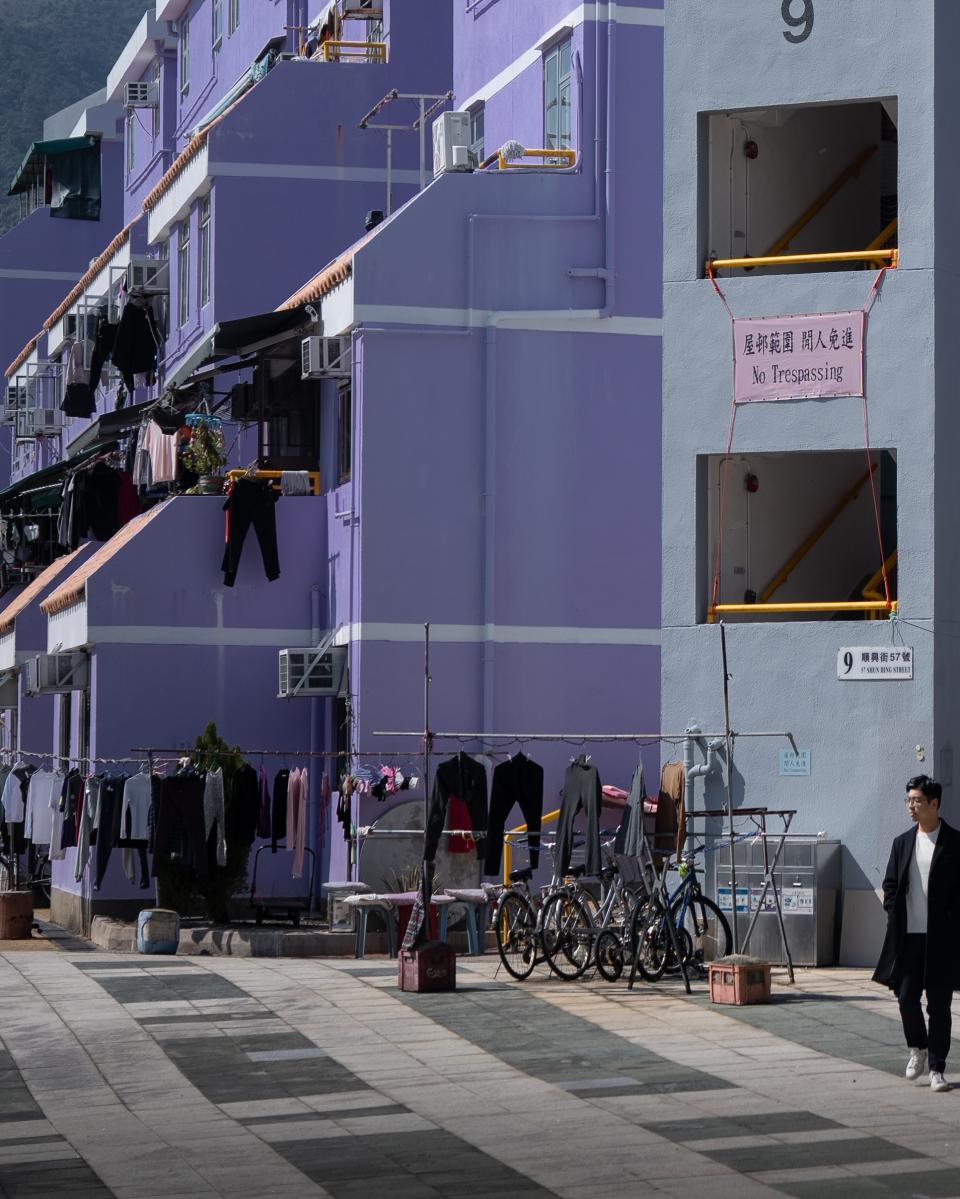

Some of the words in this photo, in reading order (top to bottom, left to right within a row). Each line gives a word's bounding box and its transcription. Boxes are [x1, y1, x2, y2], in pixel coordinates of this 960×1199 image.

[743, 330, 794, 356] 屋邨範圍
[752, 365, 766, 385] No
[772, 361, 844, 384] Trespassing
[843, 651, 854, 675] 9
